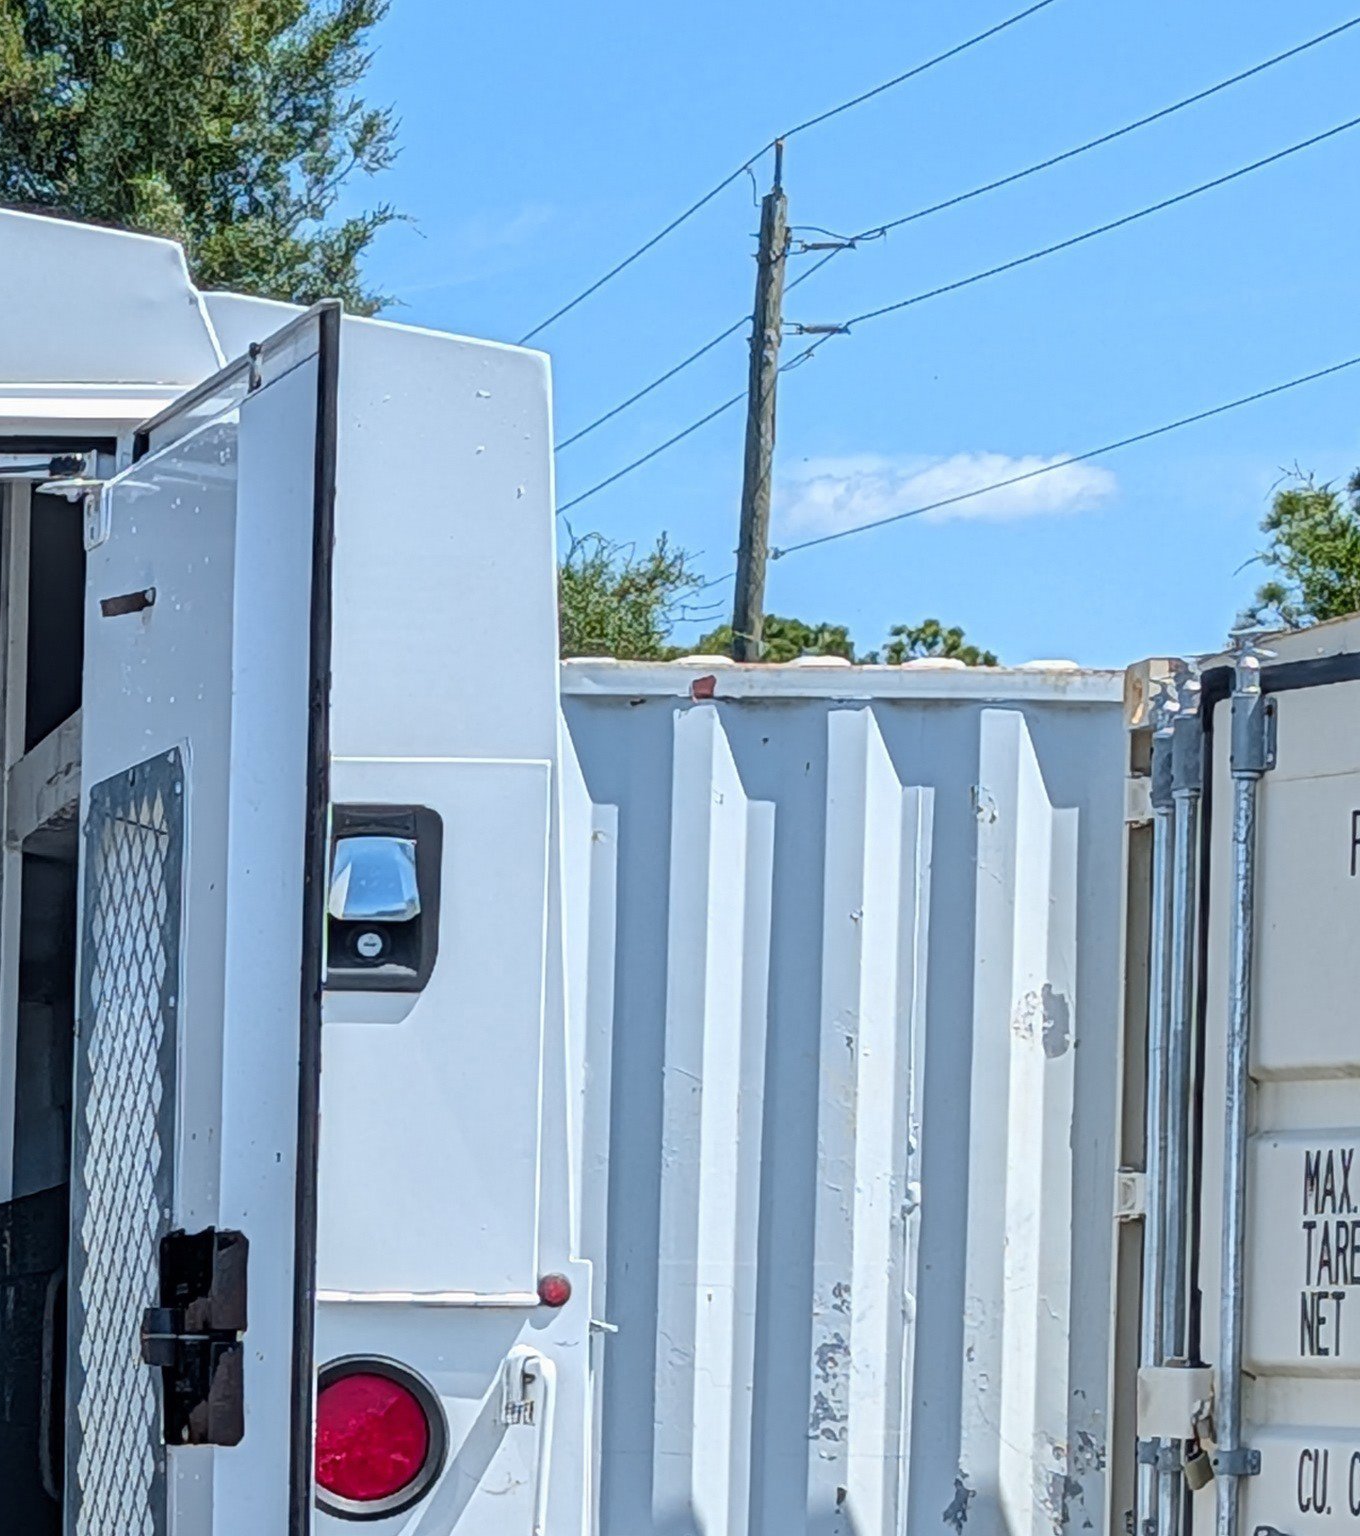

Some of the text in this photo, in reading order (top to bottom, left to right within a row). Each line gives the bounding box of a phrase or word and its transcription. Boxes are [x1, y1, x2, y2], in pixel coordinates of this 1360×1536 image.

[1302, 1147, 1358, 1217] MAX.
[1301, 1219, 1360, 1287] TARE
[1299, 1290, 1346, 1357] NET
[1297, 1447, 1332, 1515] CU.
